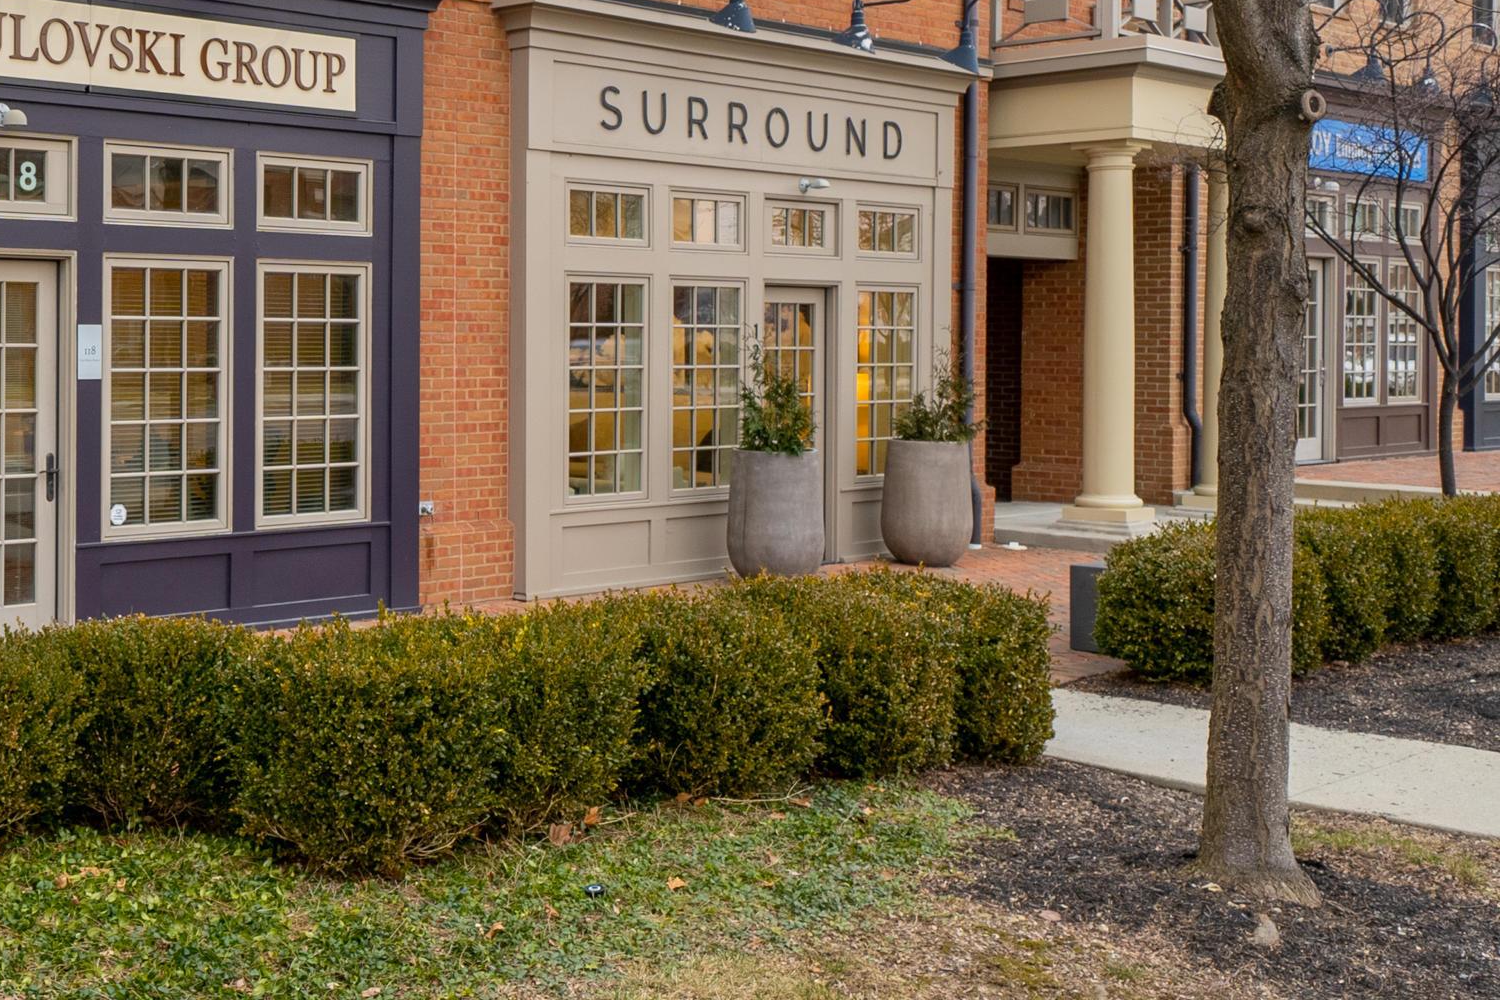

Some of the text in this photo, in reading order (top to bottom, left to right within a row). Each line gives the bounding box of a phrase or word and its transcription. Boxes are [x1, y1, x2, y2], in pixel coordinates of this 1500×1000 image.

[200, 37, 347, 94] GROUP
[600, 85, 904, 160] SURROUND
[84, 345, 96, 355] 118
